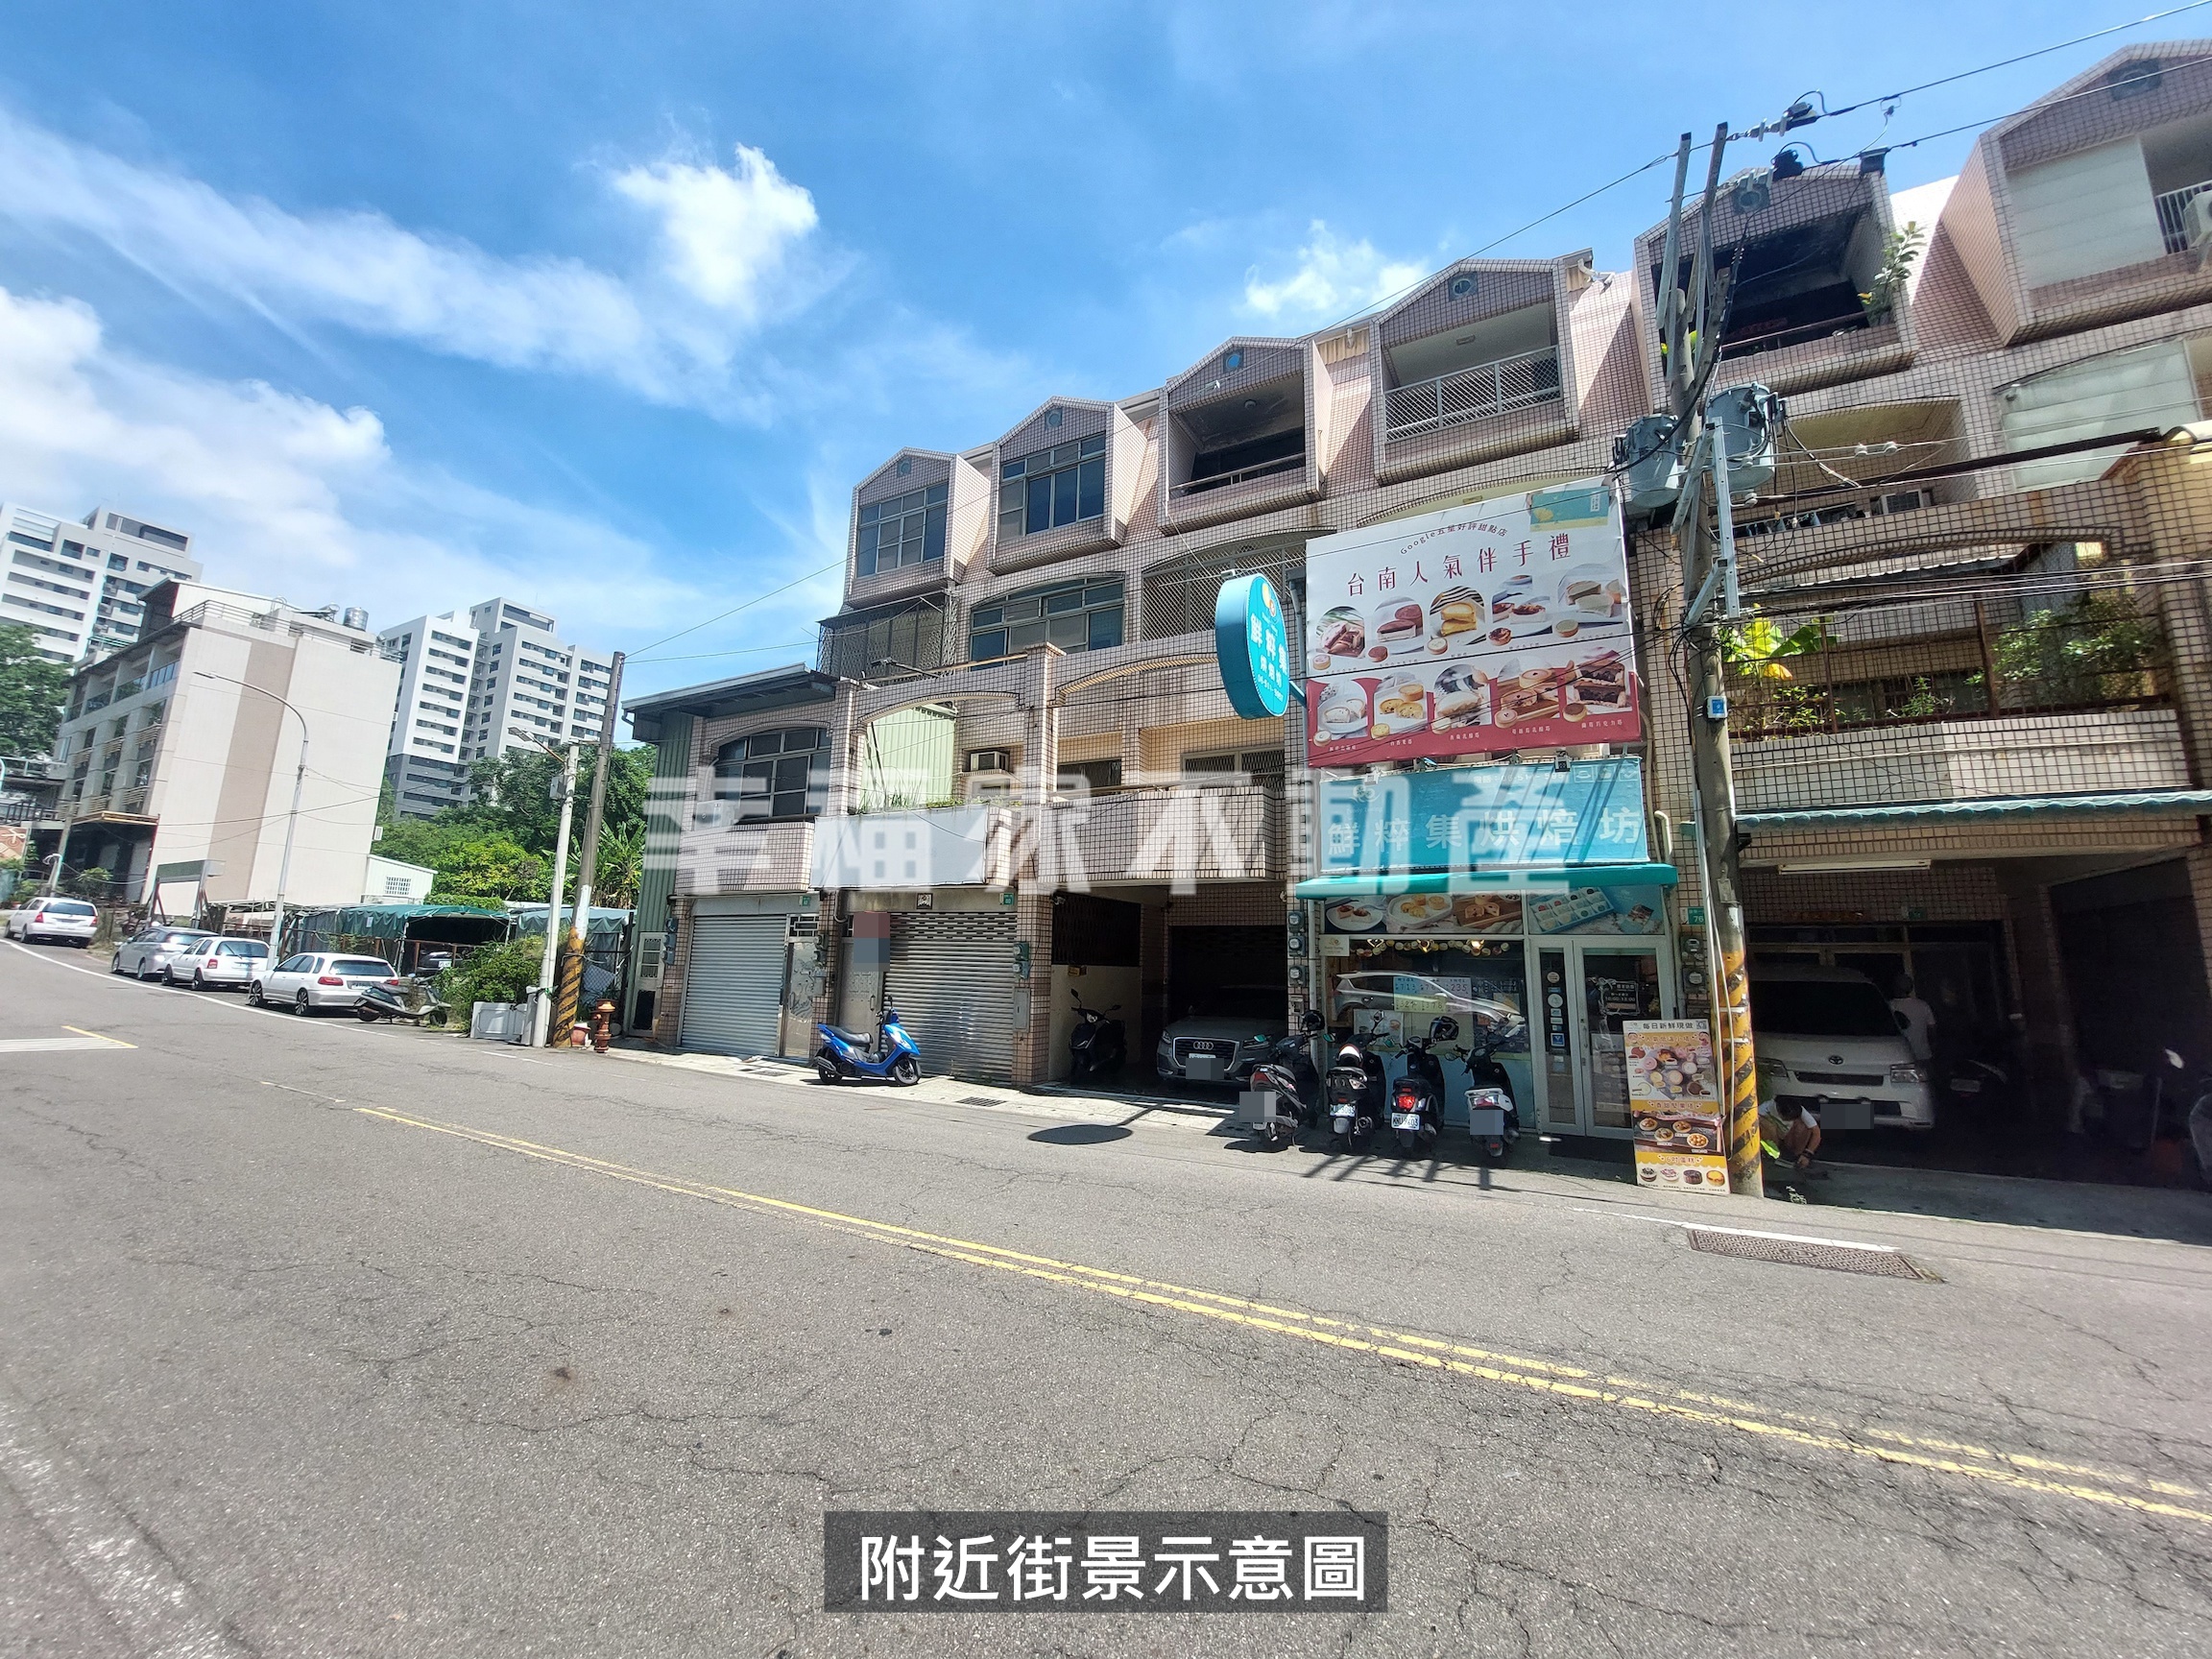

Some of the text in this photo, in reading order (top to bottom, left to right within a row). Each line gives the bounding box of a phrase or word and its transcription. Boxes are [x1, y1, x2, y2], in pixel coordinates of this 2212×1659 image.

[1400, 521, 1509, 555] Google五星好評甜點店
[1347, 532, 1572, 597] 台南人氣伴手禮
[1327, 806, 1642, 856] 鮮粹集烘焙坊
